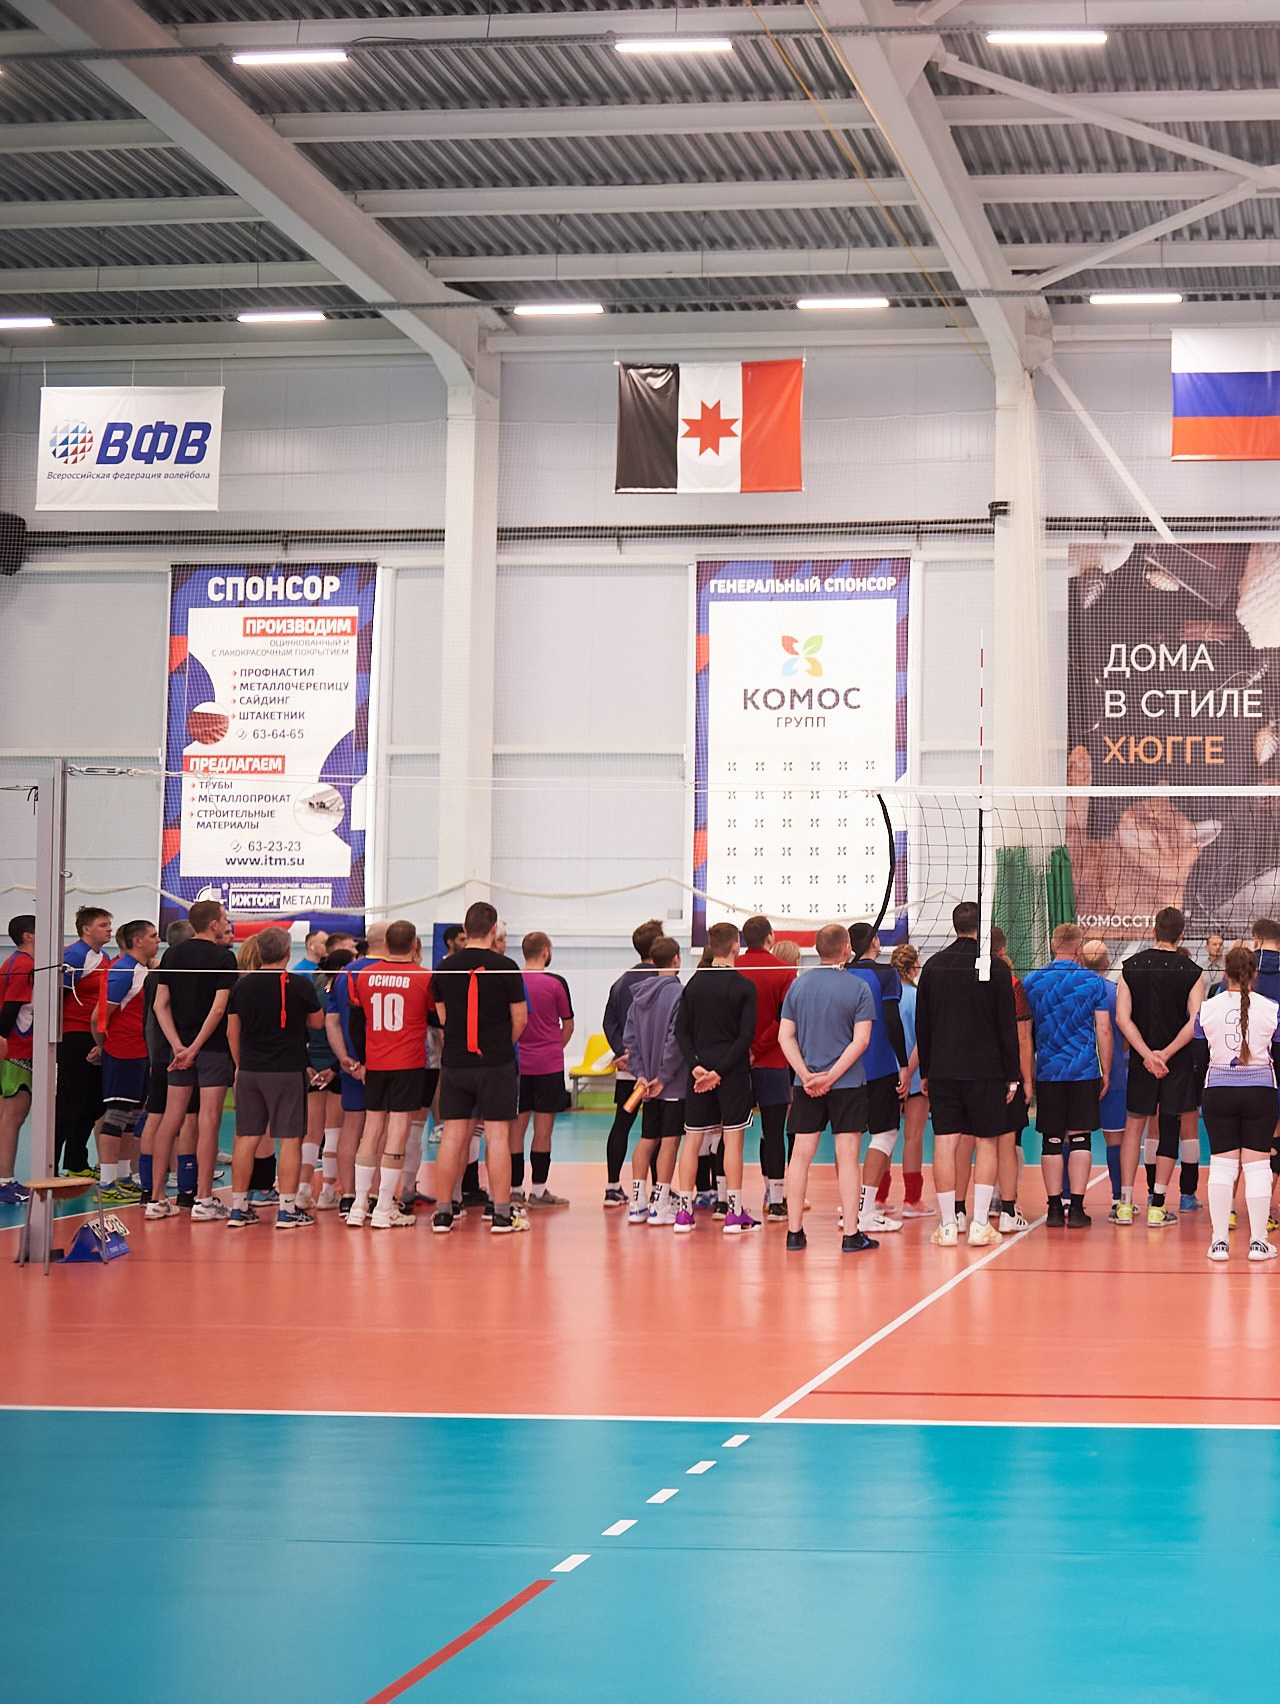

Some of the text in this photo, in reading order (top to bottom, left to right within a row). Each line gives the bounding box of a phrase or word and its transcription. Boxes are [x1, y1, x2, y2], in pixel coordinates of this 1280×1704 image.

[96, 421, 212, 464] ВФВ
[47, 471, 210, 481] Всероссийская федерация волейбола
[207, 575, 341, 601] СПОНСОР
[709, 576, 897, 594] ГЕНЕРАЛЬНЫЙ СПОНСОР
[245, 619, 352, 636] ПРОИЗВОДИМ
[269, 639, 350, 648] ОЦИНКОВАННЫЙ И
[211, 648, 349, 657] С ЛАКОКРАСОЧНЫМ ПОКРЫТИЕМ
[1103, 643, 1215, 679] ДОМА
[240, 668, 315, 678] ПРОФНАСТИЛ
[239, 682, 349, 692] МЕТАЛЛОЧЕРЕПИЦУ
[239, 696, 290, 706] САЙДИНГ
[743, 687, 861, 711] КОМОС
[1105, 690, 1263, 718] В СТИЛЕ
[239, 711, 305, 721] ШТАКЕТНИК
[776, 716, 826, 728] ГРУПП
[252, 729, 304, 739] 63-64-65
[1103, 736, 1225, 764] ХЮГГЕ
[189, 757, 283, 774] ПРЕДЛАГАЕМ
[199, 781, 233, 790] ТРУБЫ
[198, 794, 291, 803] МЕТАЛЛОПРОКАТ
[196, 810, 276, 818] СТРОИТЕЛЬНЫЕ
[196, 821, 259, 830] МАТЕРИАЛЫ
[248, 841, 301, 852] 63-23-23
[225, 855, 305, 866] www.itm.su
[1077, 914, 1157, 928] КОМОССТ
[368, 974, 411, 989] ОСИПОВ
[370, 992, 405, 1032] 10
